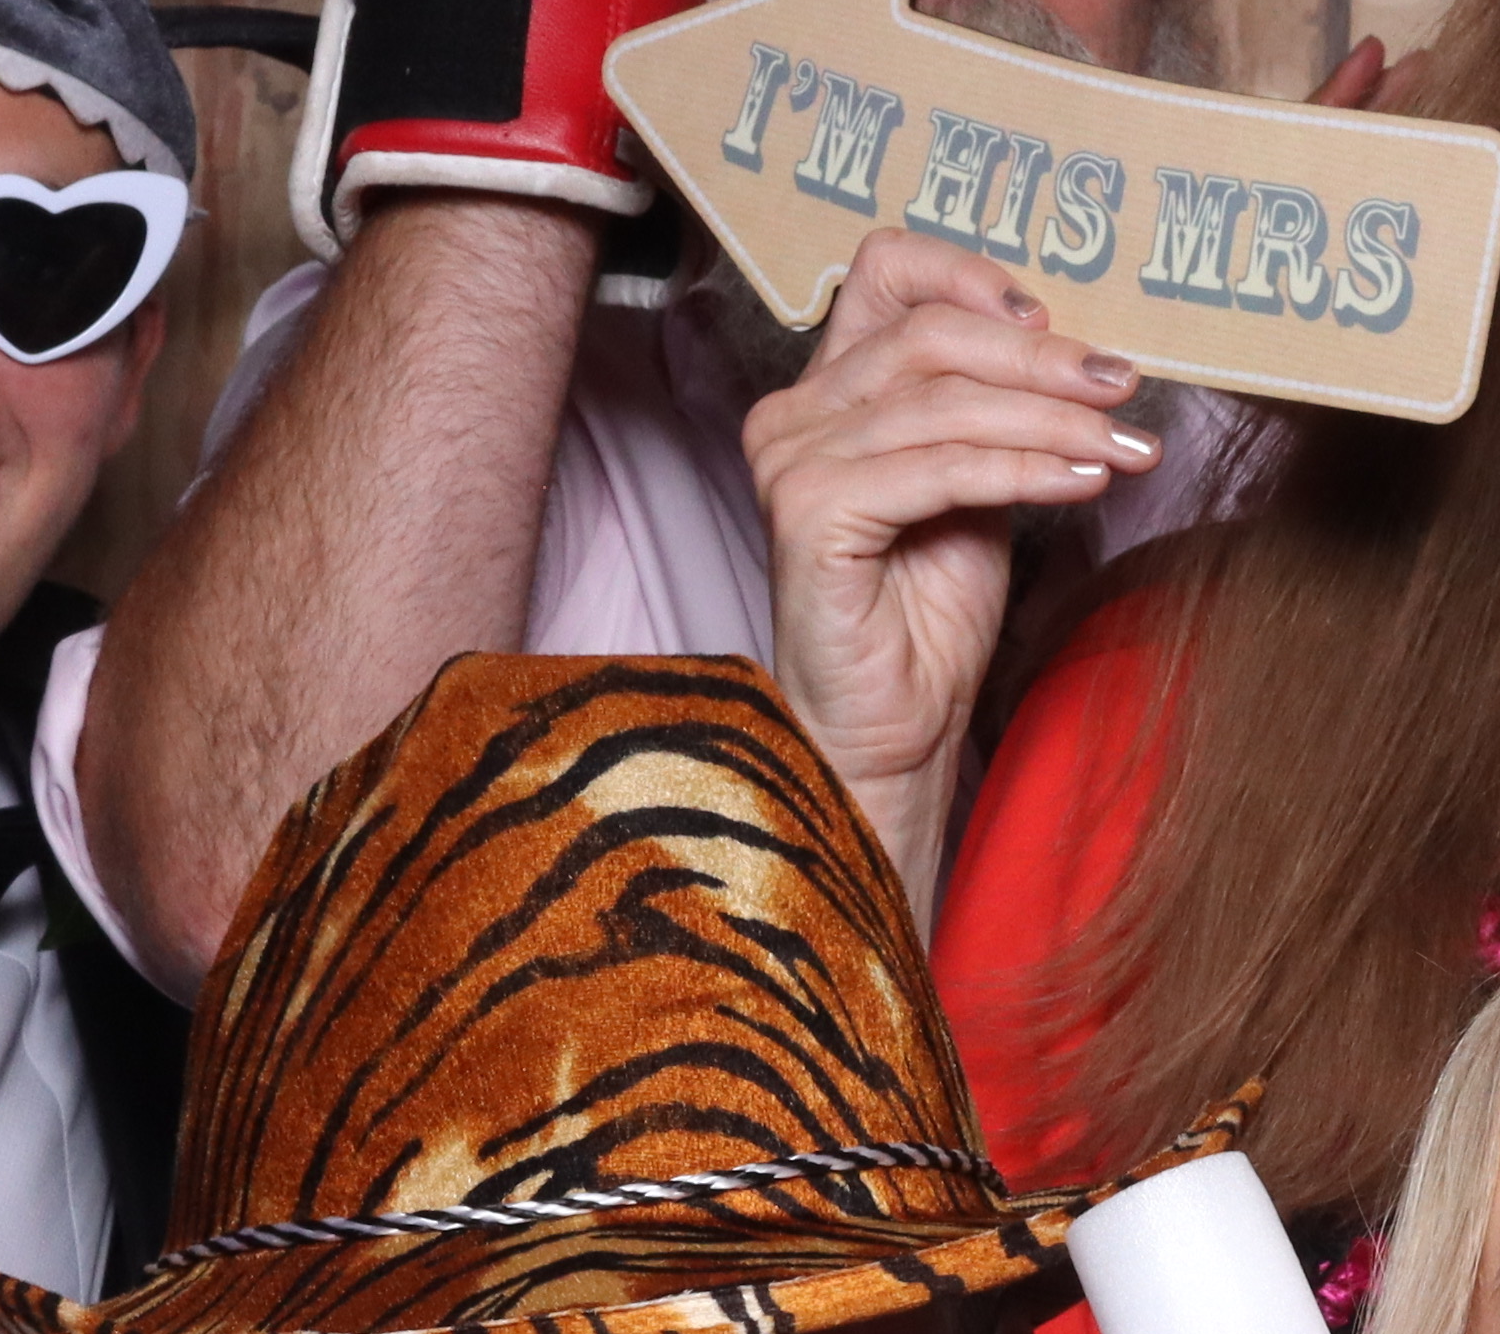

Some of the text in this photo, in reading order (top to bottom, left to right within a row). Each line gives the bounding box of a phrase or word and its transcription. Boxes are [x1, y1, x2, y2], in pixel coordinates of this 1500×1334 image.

[719, 41, 1422, 336] I'M HIS MRS
